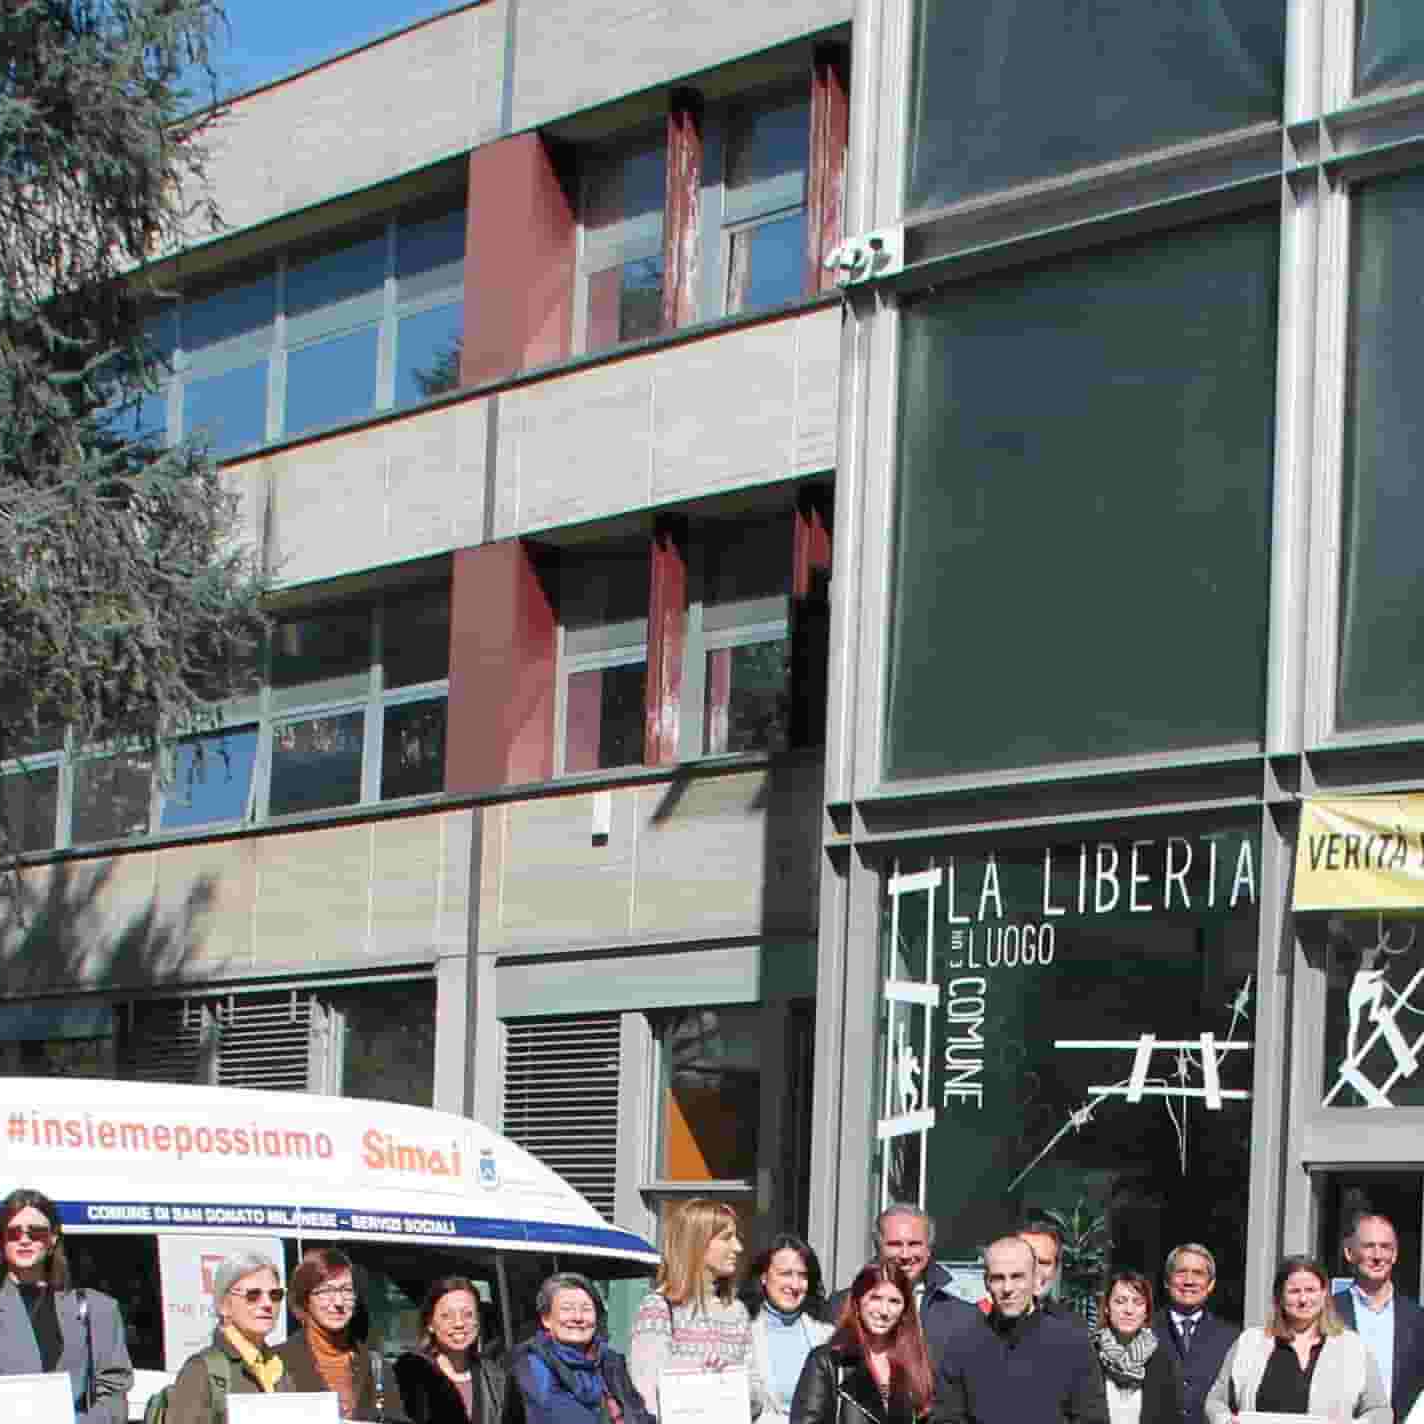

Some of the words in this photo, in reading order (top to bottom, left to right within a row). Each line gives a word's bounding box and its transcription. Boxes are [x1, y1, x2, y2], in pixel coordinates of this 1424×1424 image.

[1309, 825, 1408, 872] VERITÀ
[947, 853, 1004, 924] LA
[968, 921, 1056, 969] LUOGO
[943, 975, 987, 1110] COMUNE
[7, 1111, 334, 1160] #insiemepossiamo
[87, 1204, 152, 1221] COMUNE
[172, 1206, 204, 1222] SAN
[205, 1208, 265, 1224] DONATO
